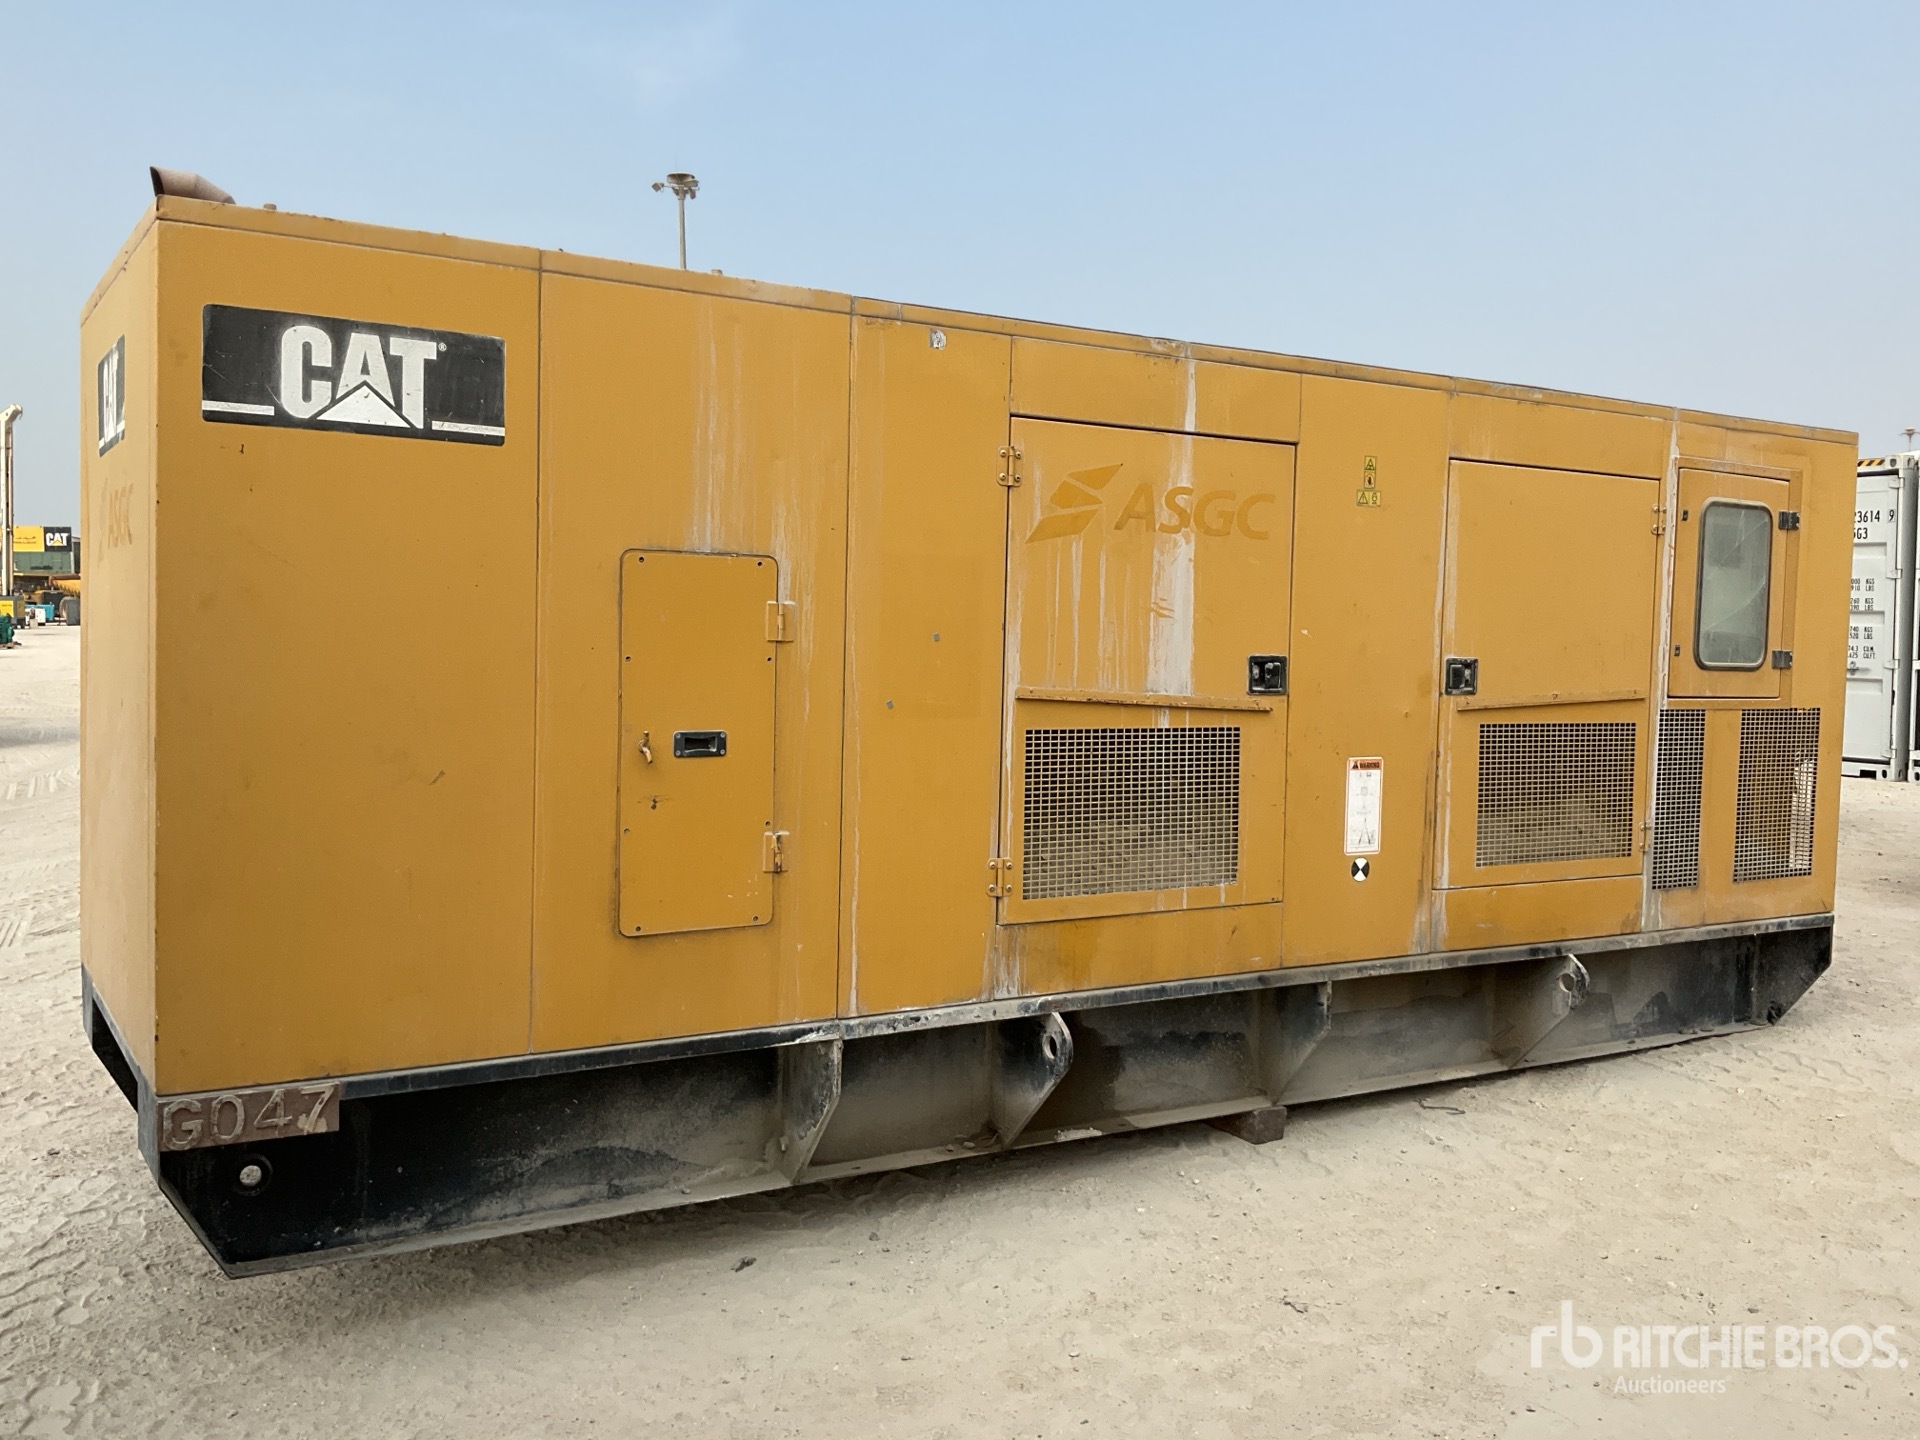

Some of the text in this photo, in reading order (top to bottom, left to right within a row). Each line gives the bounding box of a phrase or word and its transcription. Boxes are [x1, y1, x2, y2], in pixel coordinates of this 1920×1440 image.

[281, 325, 438, 430] CAT
[1113, 482, 1276, 541] ASGC
[1889, 509, 1895, 522] 9
[45, 532, 70, 547] CAT
